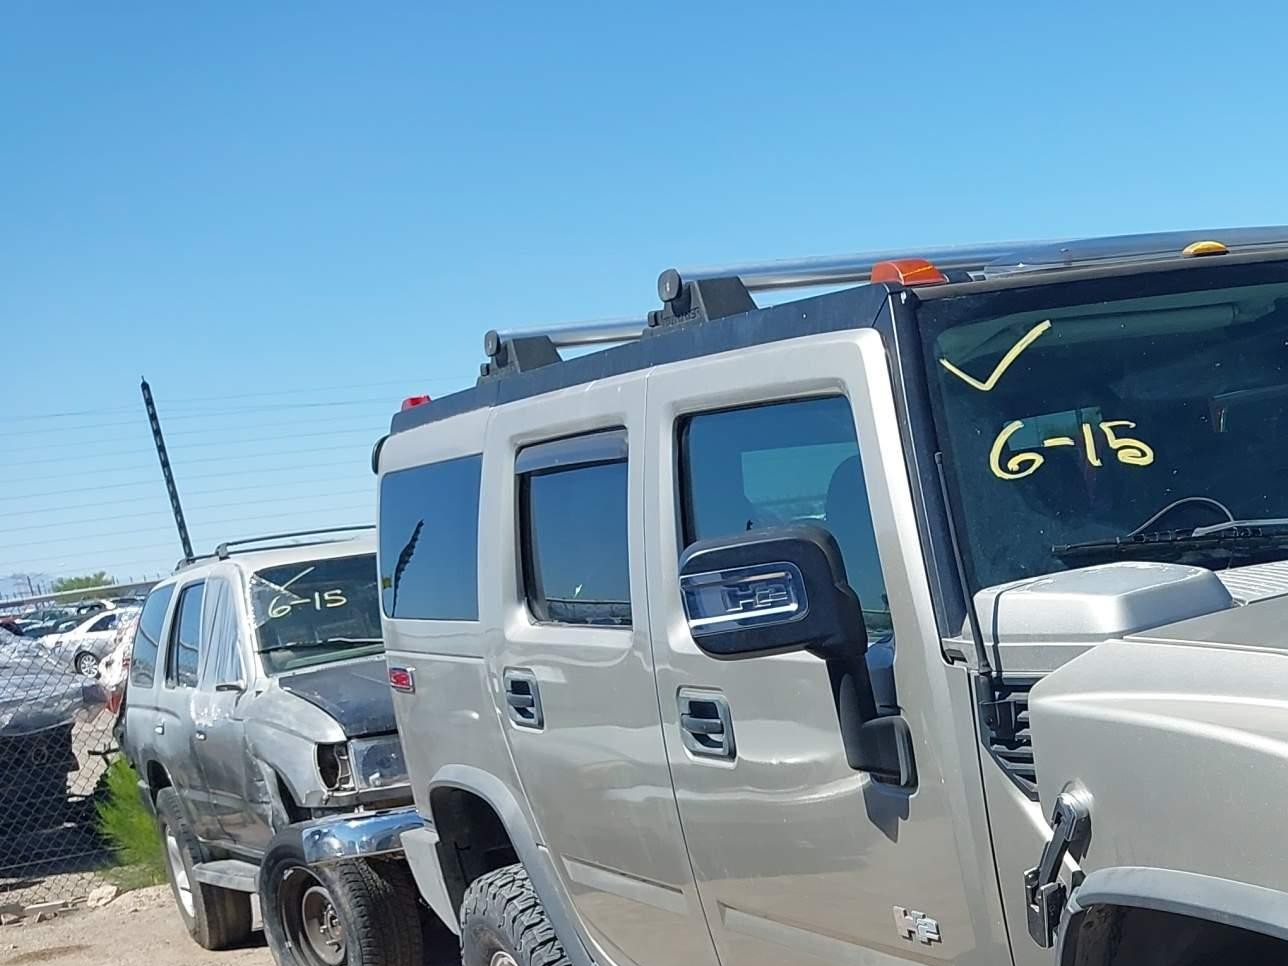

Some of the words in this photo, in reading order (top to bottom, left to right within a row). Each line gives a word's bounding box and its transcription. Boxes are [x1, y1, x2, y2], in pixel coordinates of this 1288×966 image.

[989, 420, 1154, 480] 6-15
[268, 589, 348, 619] 6-15
[893, 904, 942, 946] H2
